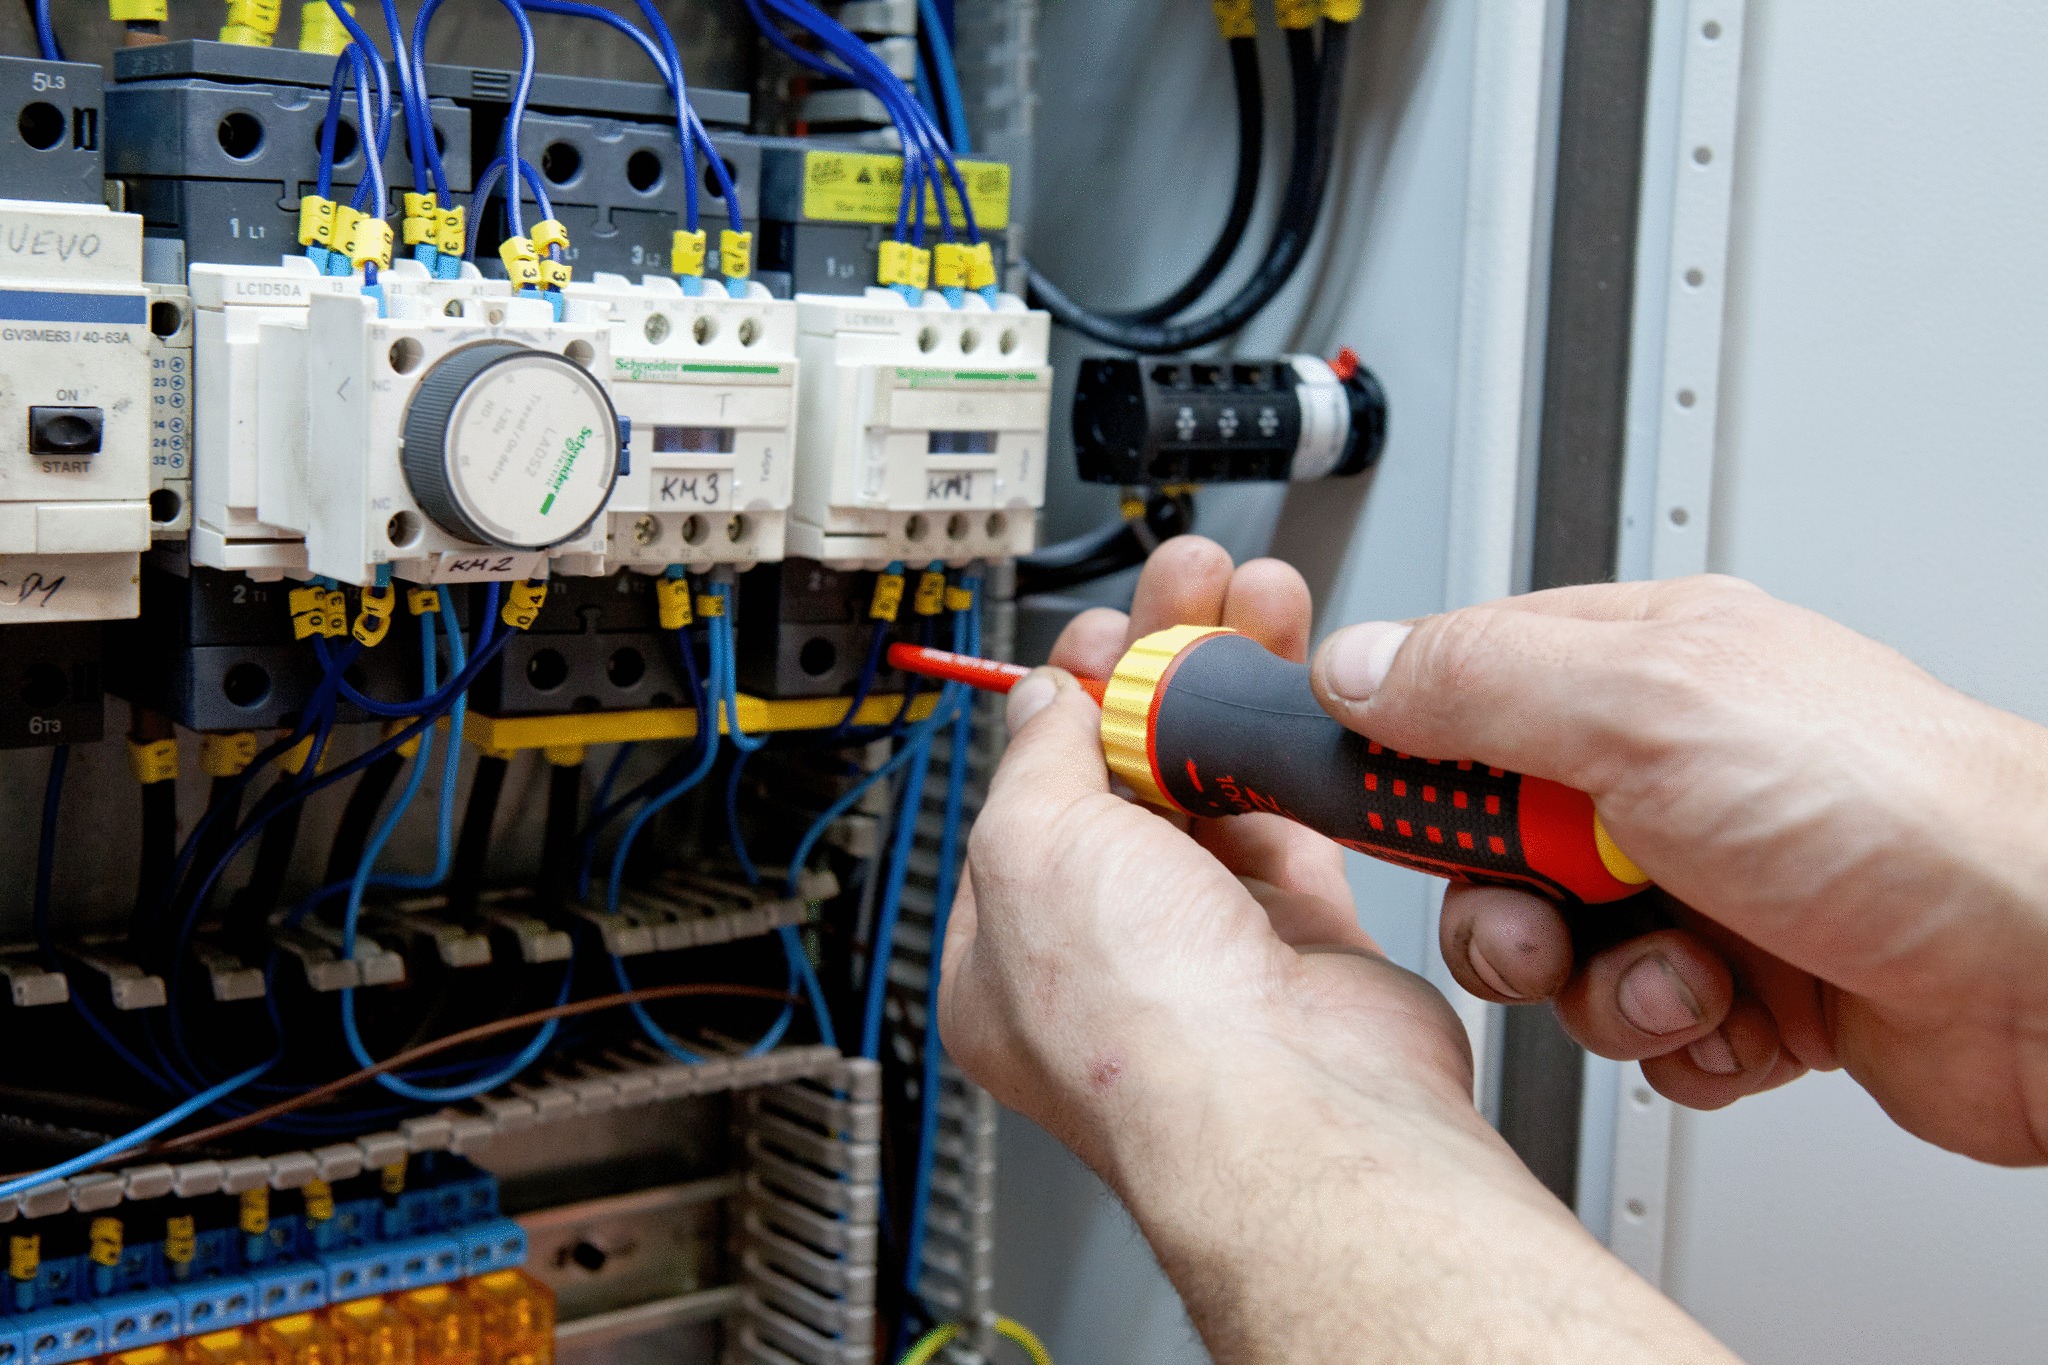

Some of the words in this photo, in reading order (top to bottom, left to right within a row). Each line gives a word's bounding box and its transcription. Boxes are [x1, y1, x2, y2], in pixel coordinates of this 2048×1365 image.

[0, 223, 100, 260] UEVO
[237, 282, 300, 297] LC1D50A
[3, 328, 72, 343] GV3ME63
[83, 331, 131, 345] 40-63A
[153, 359, 166, 369] 31
[153, 378, 167, 388] 23
[57, 390, 78, 401] ON
[153, 438, 167, 448] 24
[153, 456, 167, 466] 32
[43, 461, 91, 473] START
[661, 473, 720, 505] KM3
